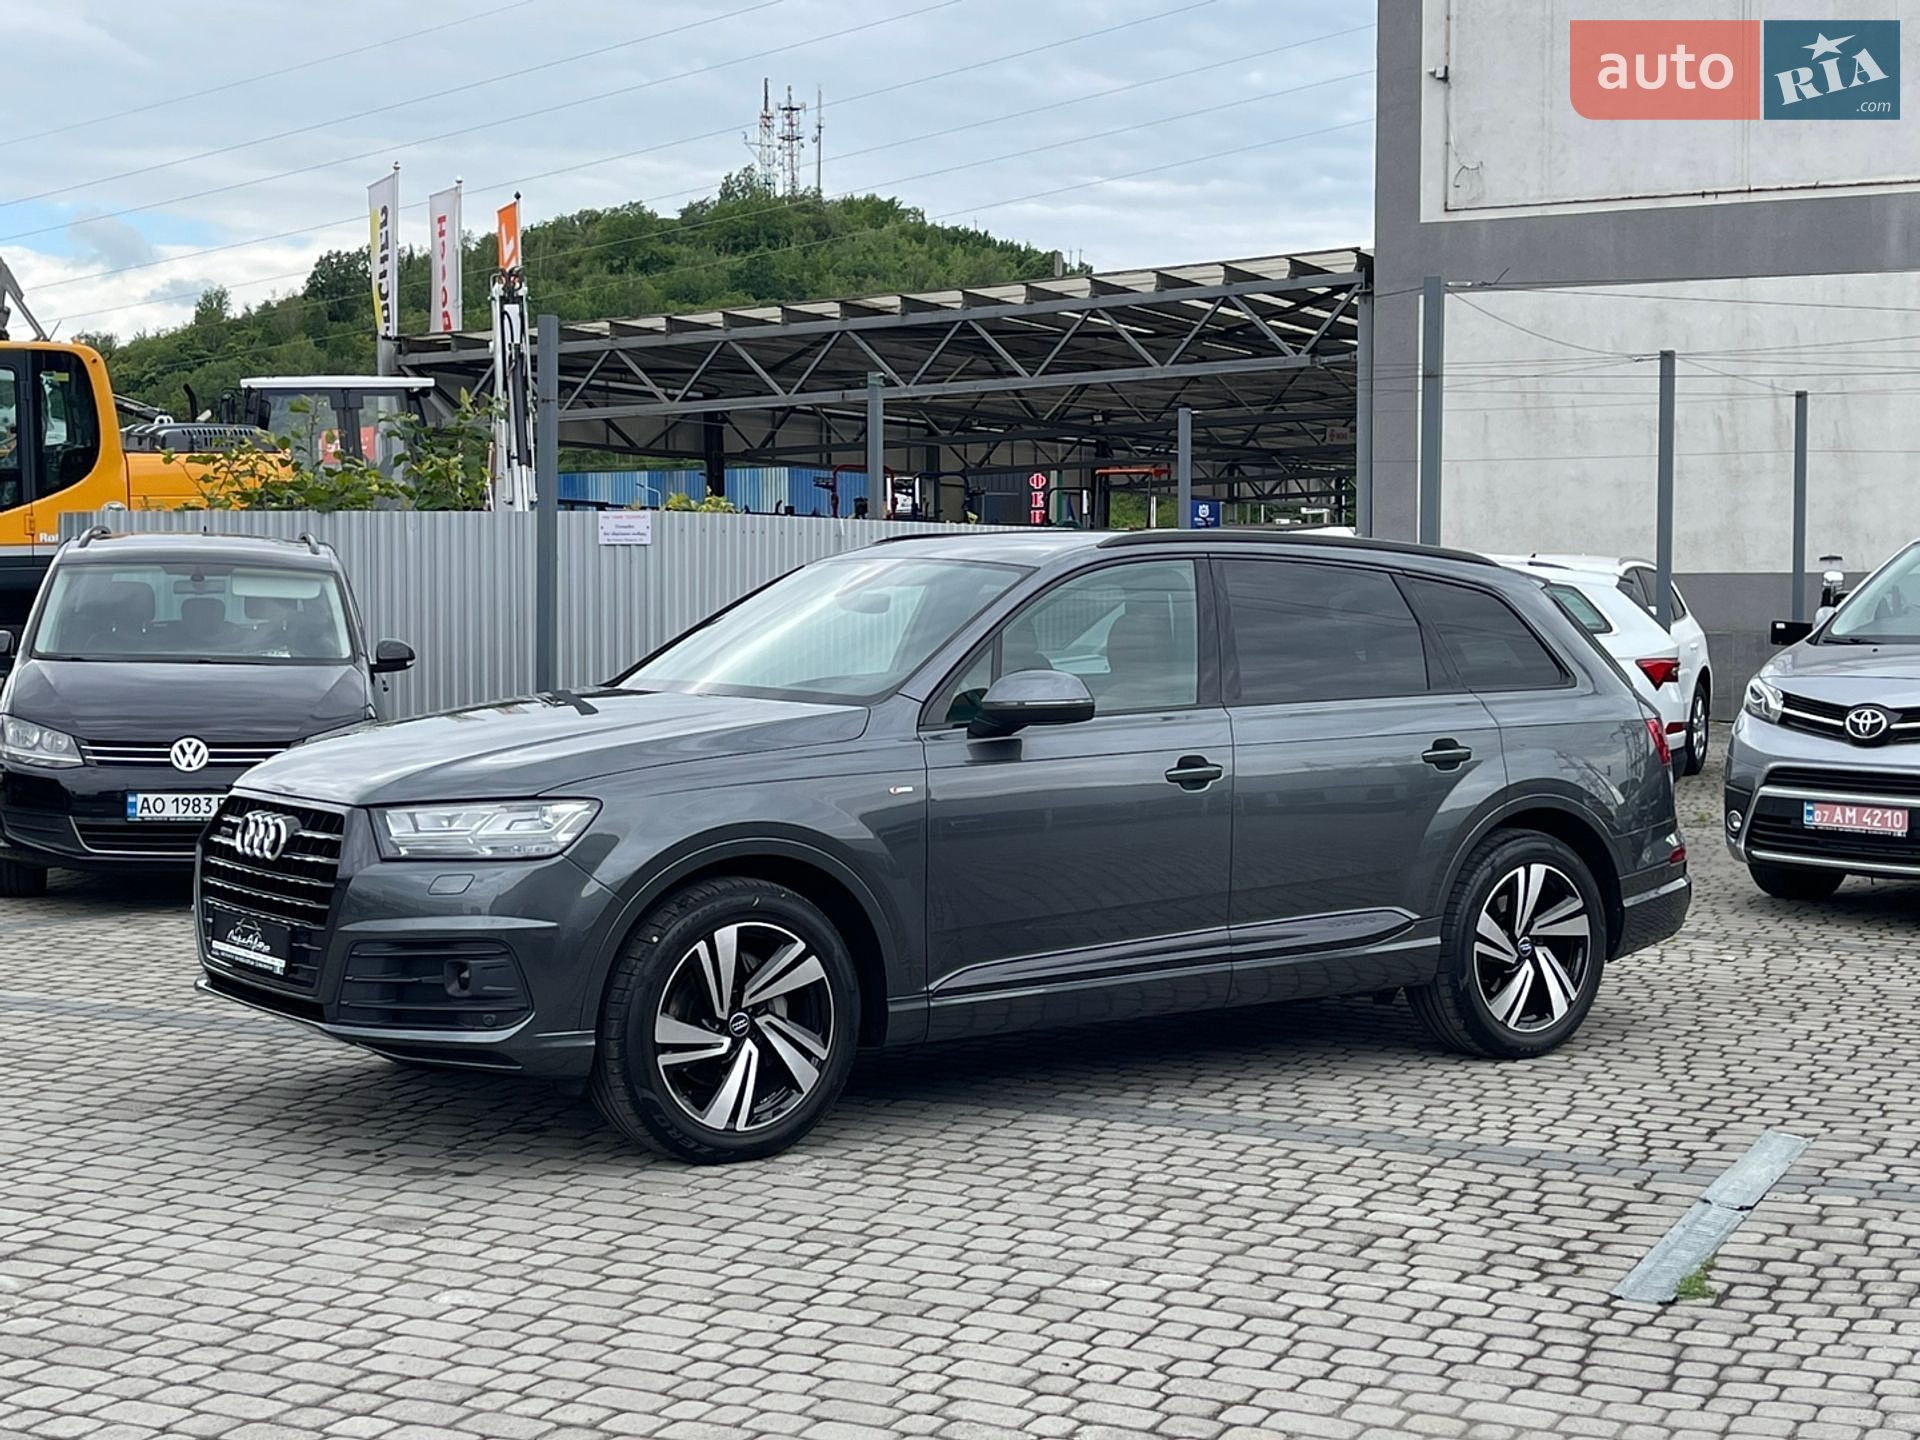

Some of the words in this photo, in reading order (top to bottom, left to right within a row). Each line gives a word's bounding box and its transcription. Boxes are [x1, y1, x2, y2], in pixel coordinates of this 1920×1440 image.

[139, 797, 165, 814] AO
[171, 797, 212, 814] 1983
[1813, 810, 1829, 823] 07
[1833, 806, 1857, 825] AM
[1862, 808, 1903, 828] 4210
